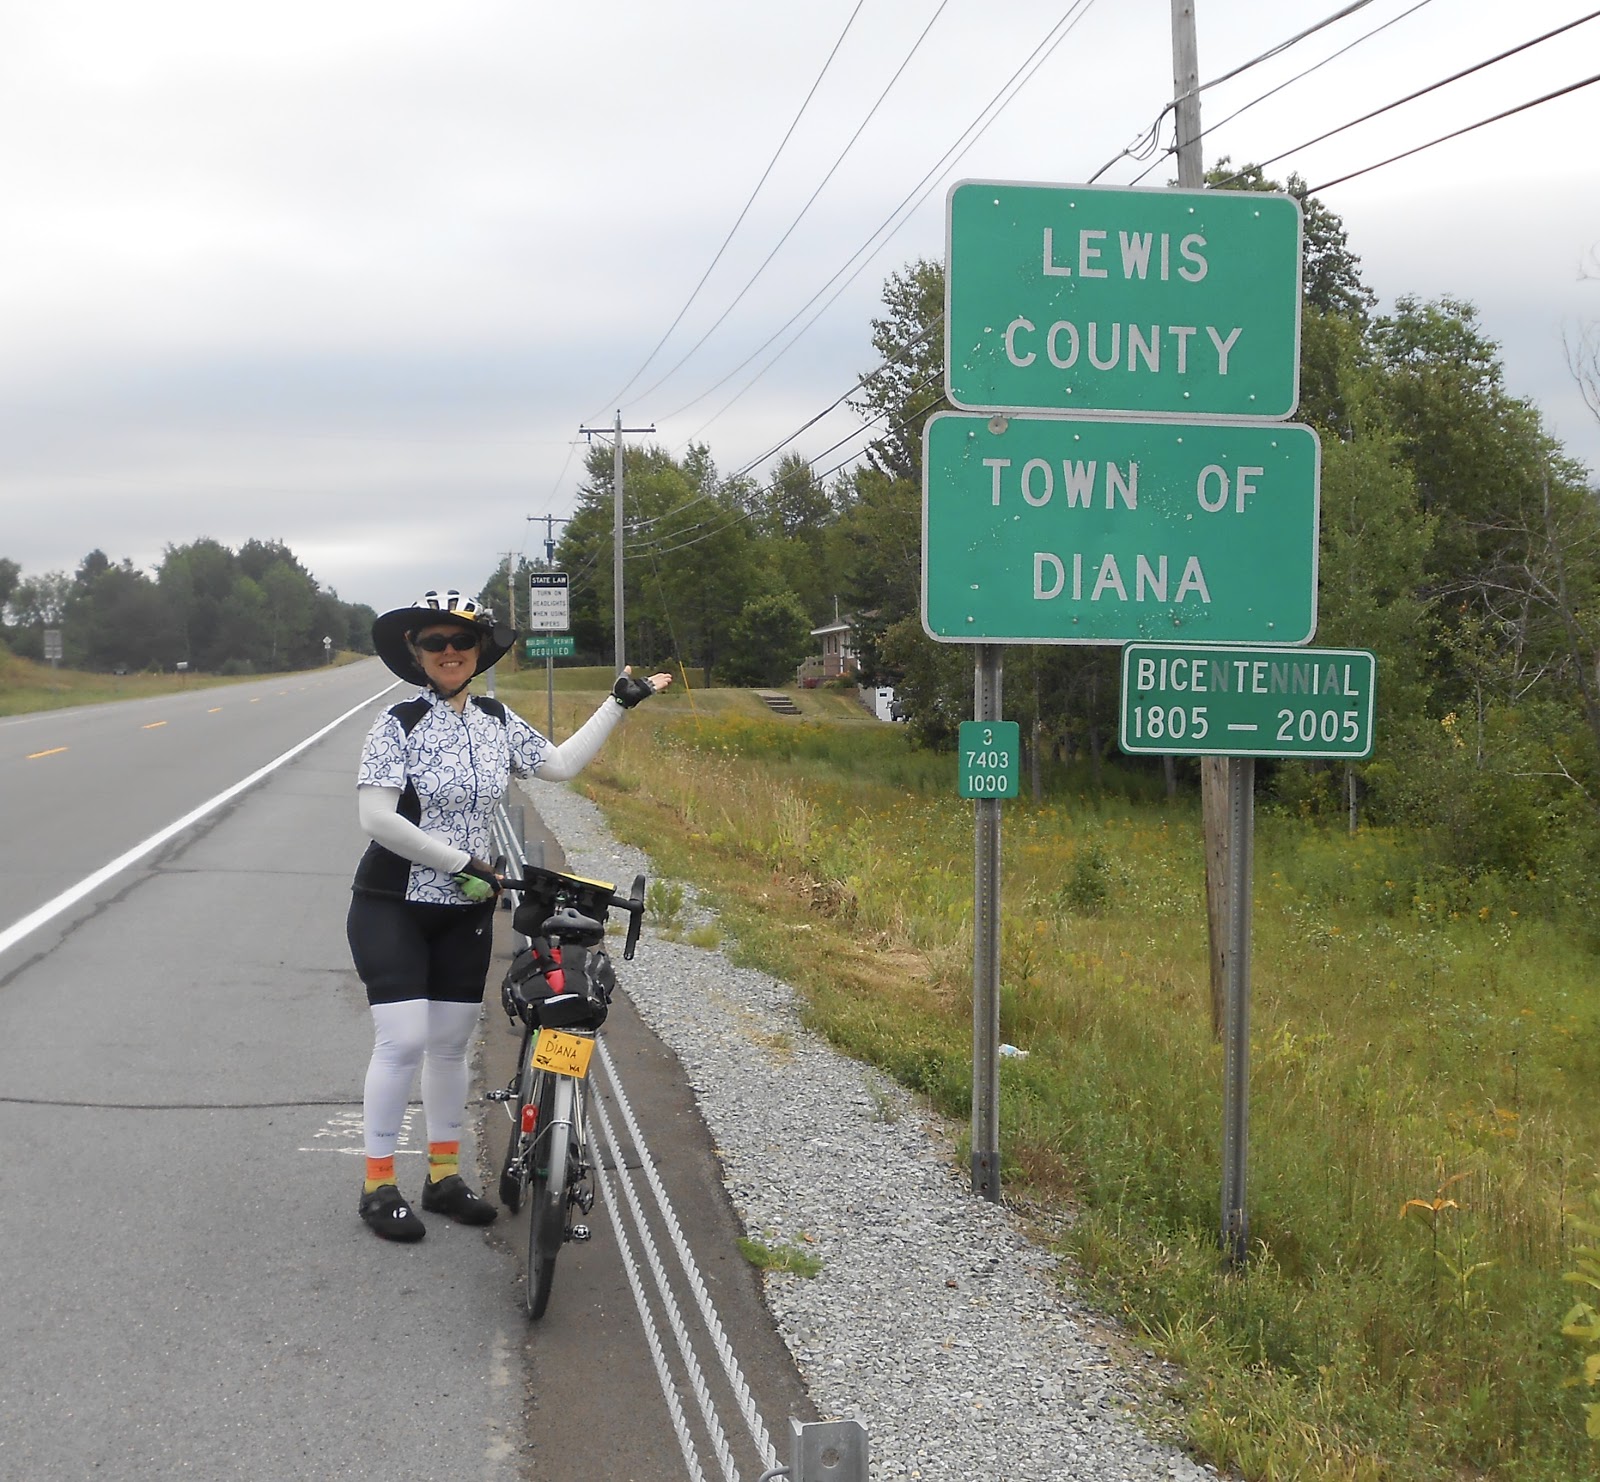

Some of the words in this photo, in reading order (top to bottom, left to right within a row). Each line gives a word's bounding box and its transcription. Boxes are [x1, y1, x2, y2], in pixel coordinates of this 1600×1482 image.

[1042, 227, 1209, 282] LEWIS
[1003, 316, 1243, 375] COUNTY
[982, 458, 1138, 510] TOWN
[1197, 464, 1264, 513] OF
[1032, 552, 1212, 603] DIANA
[531, 647, 569, 656] REQUIRED
[1137, 658, 1359, 696] BICENTENNIAL
[983, 728, 993, 745] 3
[1134, 705, 1208, 739] 1805
[1276, 709, 1359, 743] 2005
[966, 751, 1009, 768] 7403
[968, 775, 1008, 792] 1000
[545, 1040, 577, 1059] DIANA
[569, 1064, 580, 1073] WA
